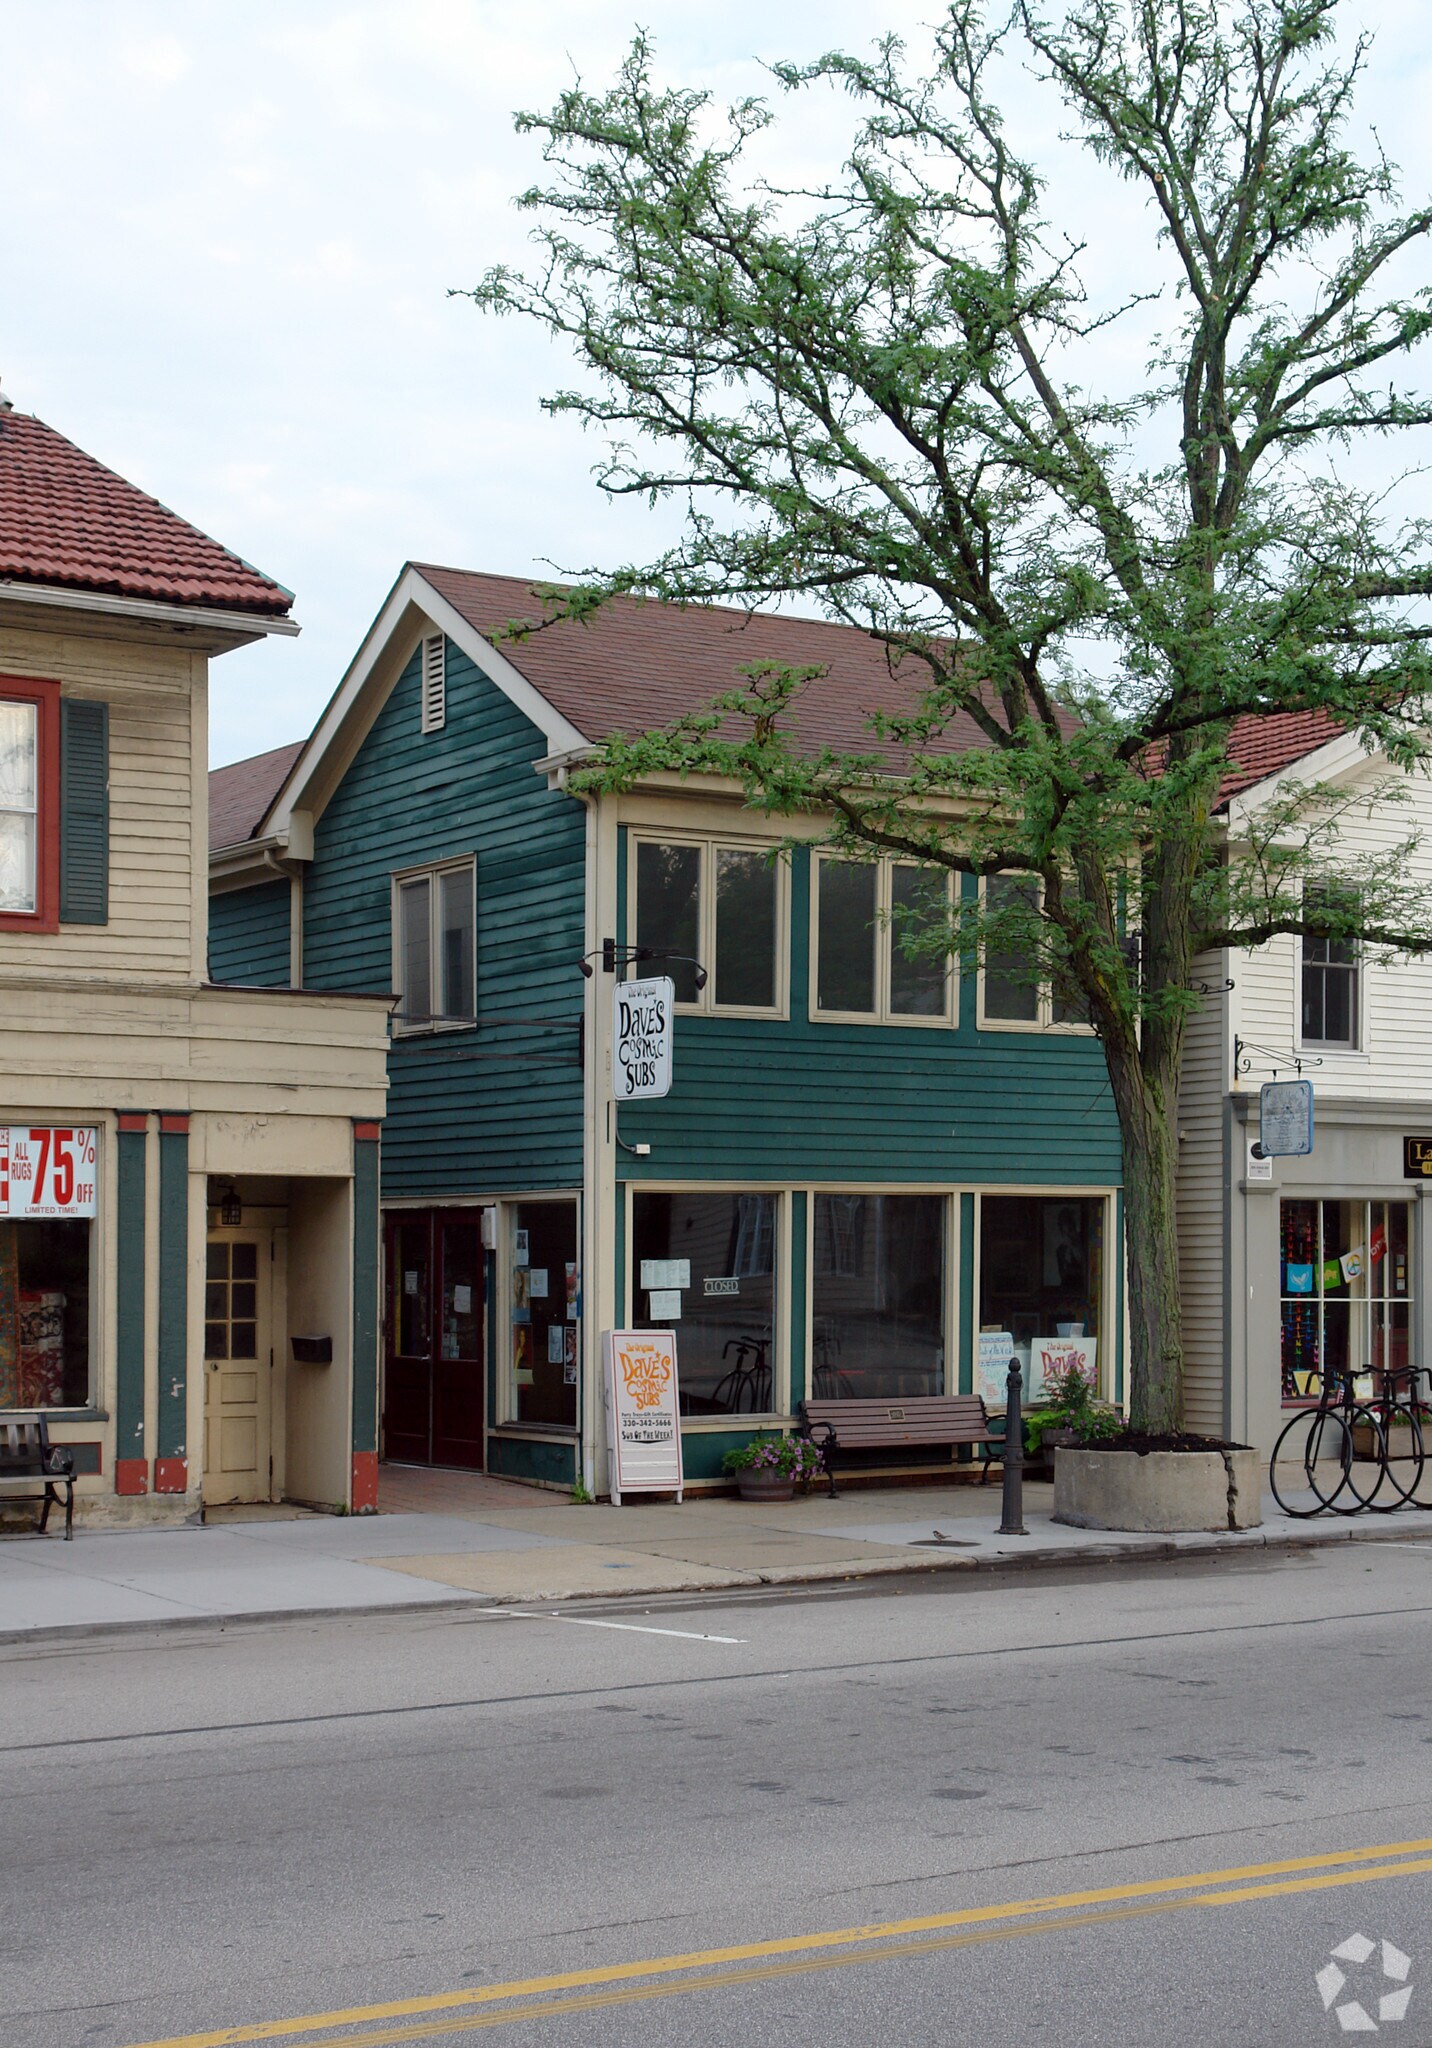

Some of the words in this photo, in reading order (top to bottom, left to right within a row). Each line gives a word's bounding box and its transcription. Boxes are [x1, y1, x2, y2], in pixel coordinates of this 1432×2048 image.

[626, 1061, 656, 1095] SUBS
[14, 1142, 28, 1160] ALL
[11, 1162, 32, 1181] RUGS
[76, 1183, 93, 1203] OFF
[24, 1206, 56, 1214] LIMITED
[58, 1206, 79, 1214] TIME!
[704, 1280, 738, 1293] CLOSED
[636, 1392, 660, 1410] SUBS
